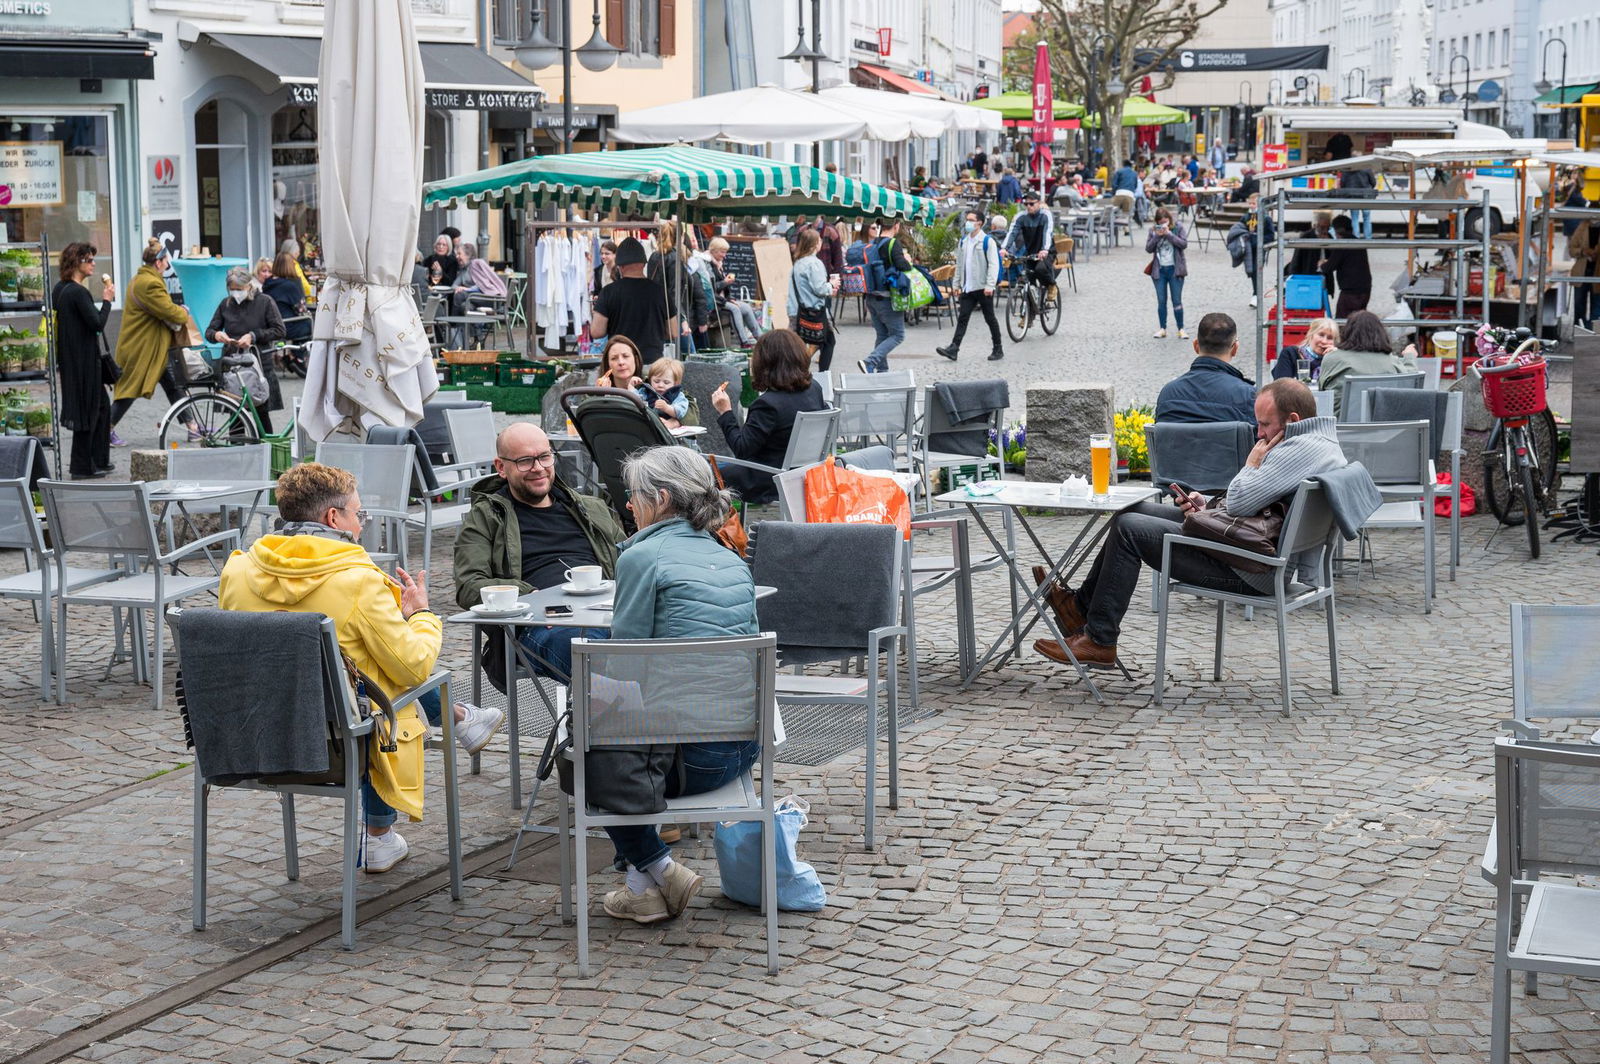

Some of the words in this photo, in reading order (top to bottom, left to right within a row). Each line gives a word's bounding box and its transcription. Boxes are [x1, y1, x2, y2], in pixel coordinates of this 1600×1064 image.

[293, 87, 319, 102] KON
[432, 93, 459, 106] STORE
[480, 94, 536, 108] KONTRAST
[548, 116, 564, 127] TANT
[25, 160, 55, 168] ZURÜCK!
